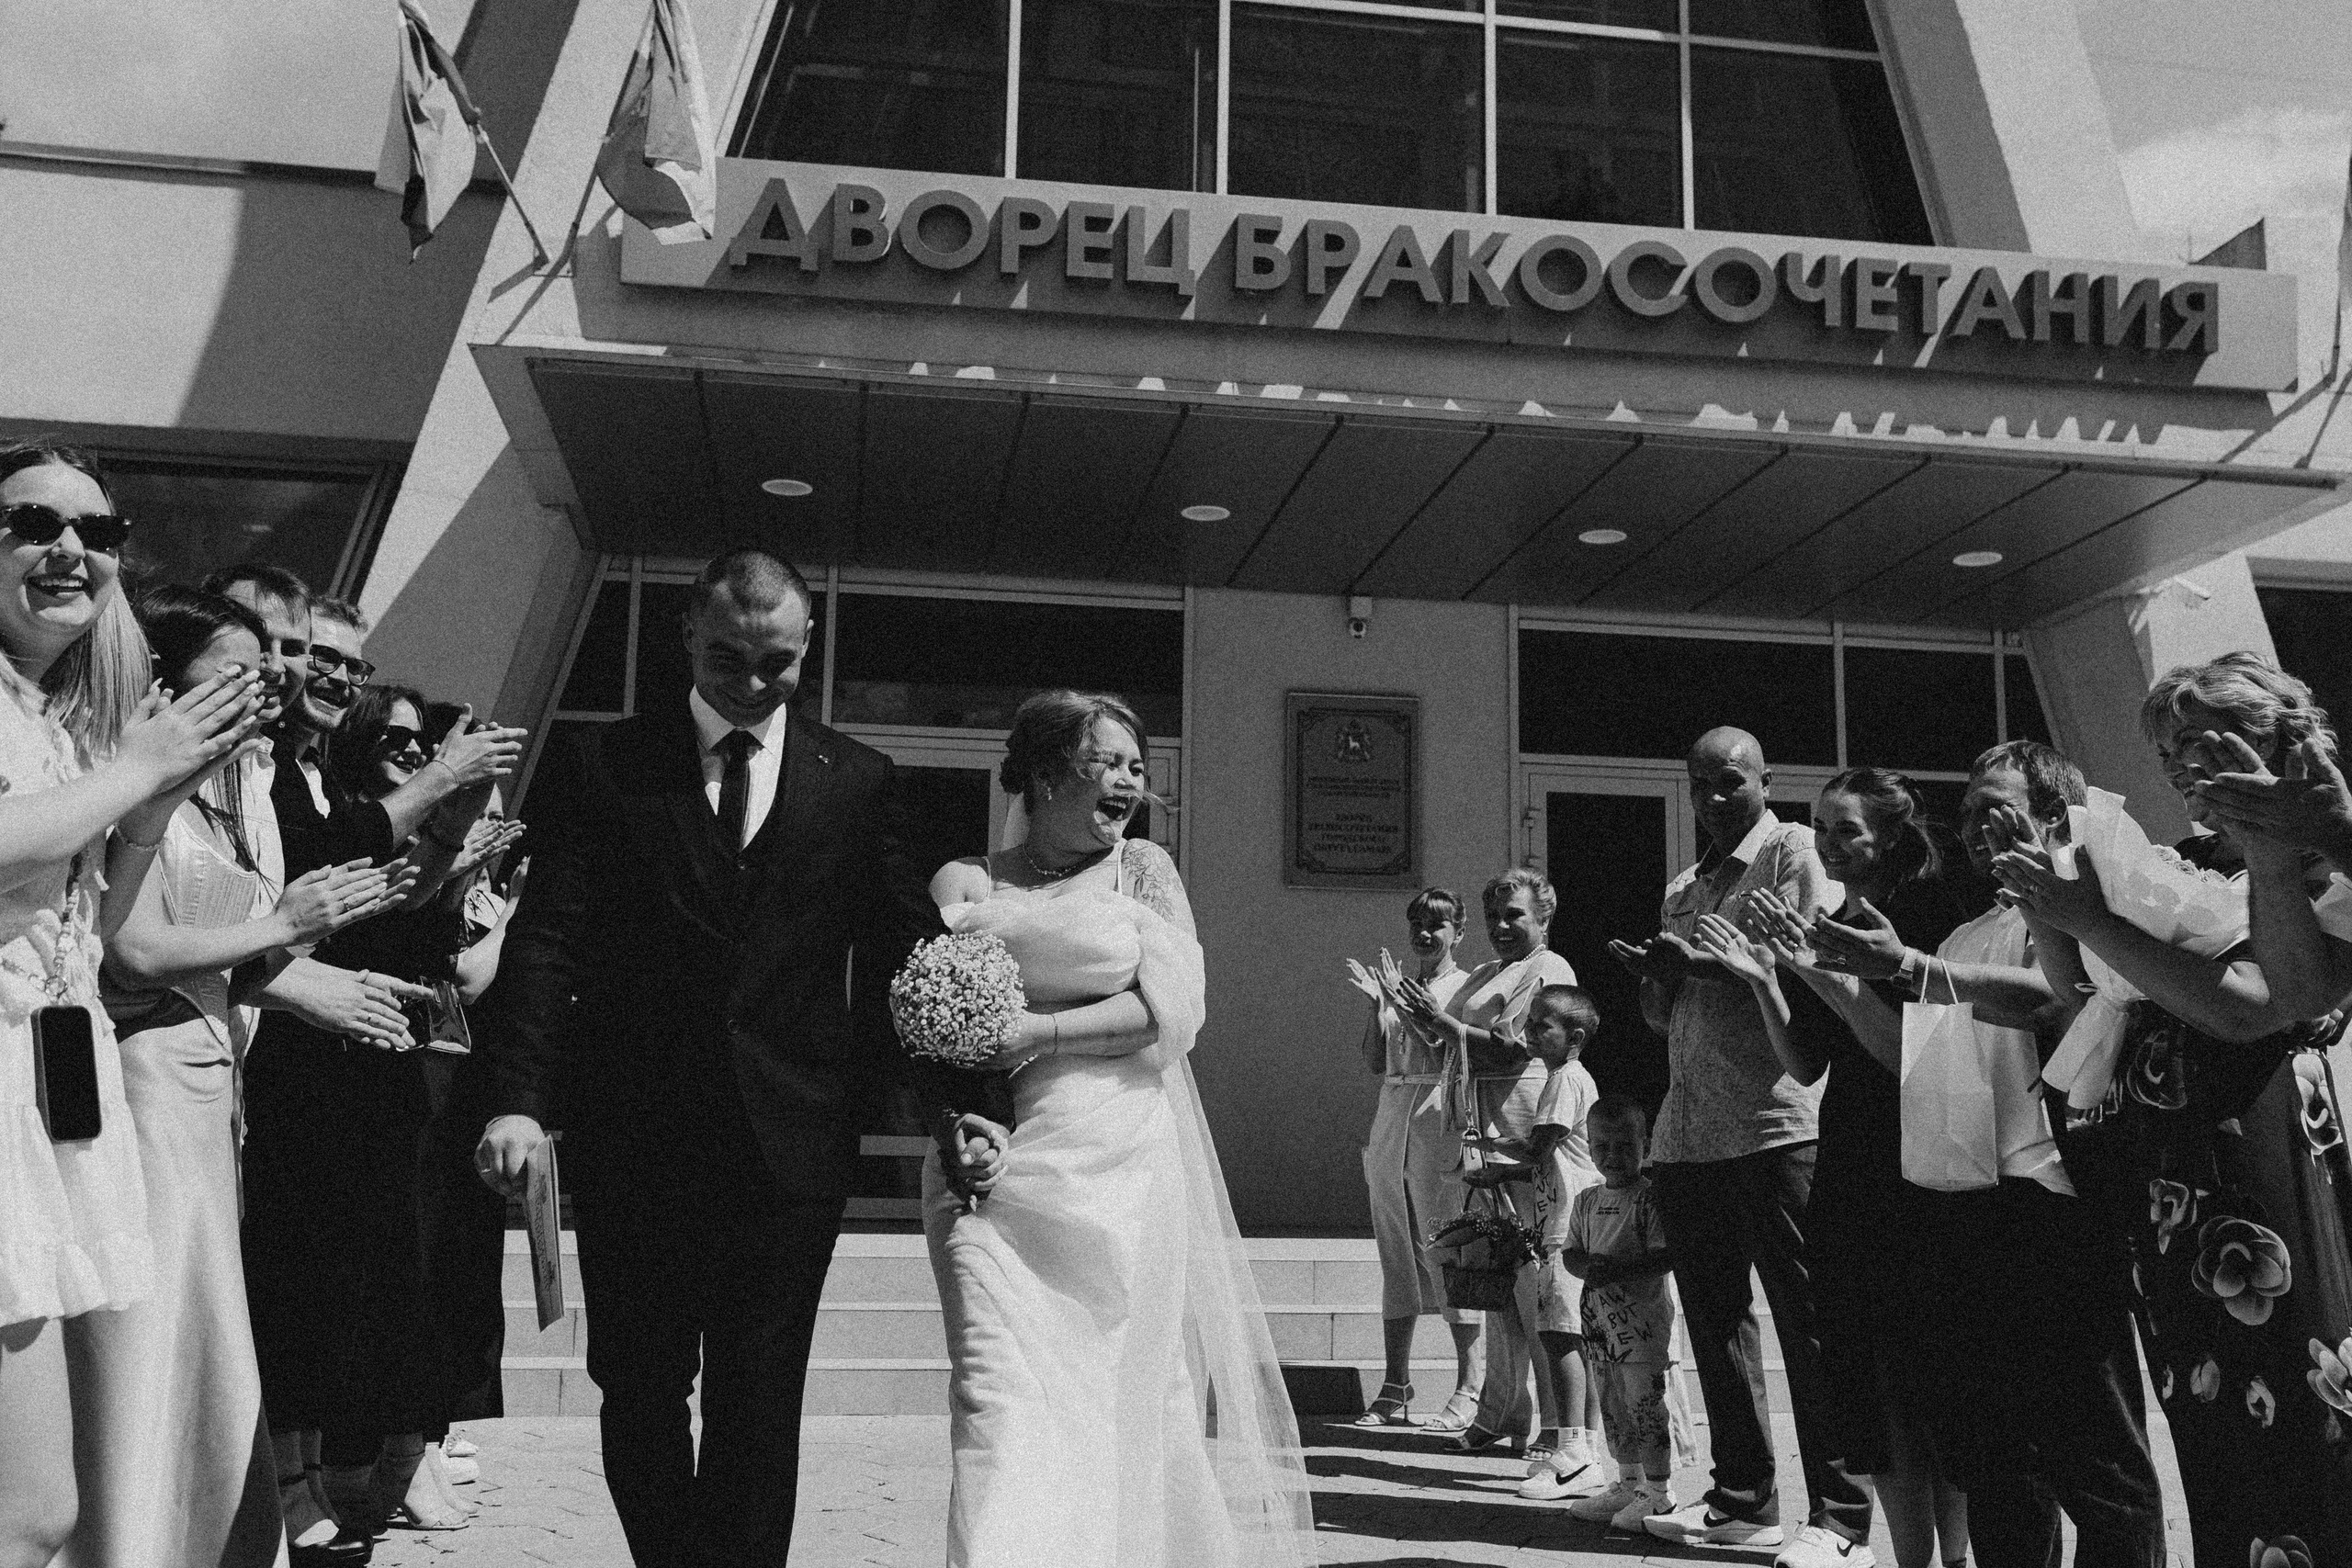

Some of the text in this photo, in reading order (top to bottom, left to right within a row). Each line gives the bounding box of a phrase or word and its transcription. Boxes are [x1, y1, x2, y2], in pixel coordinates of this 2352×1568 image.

[729, 176, 2220, 353] ДВОРЕЦ БРАКОСОЧЕТАНИЯ
[1607, 1302, 1637, 1329] BUT
